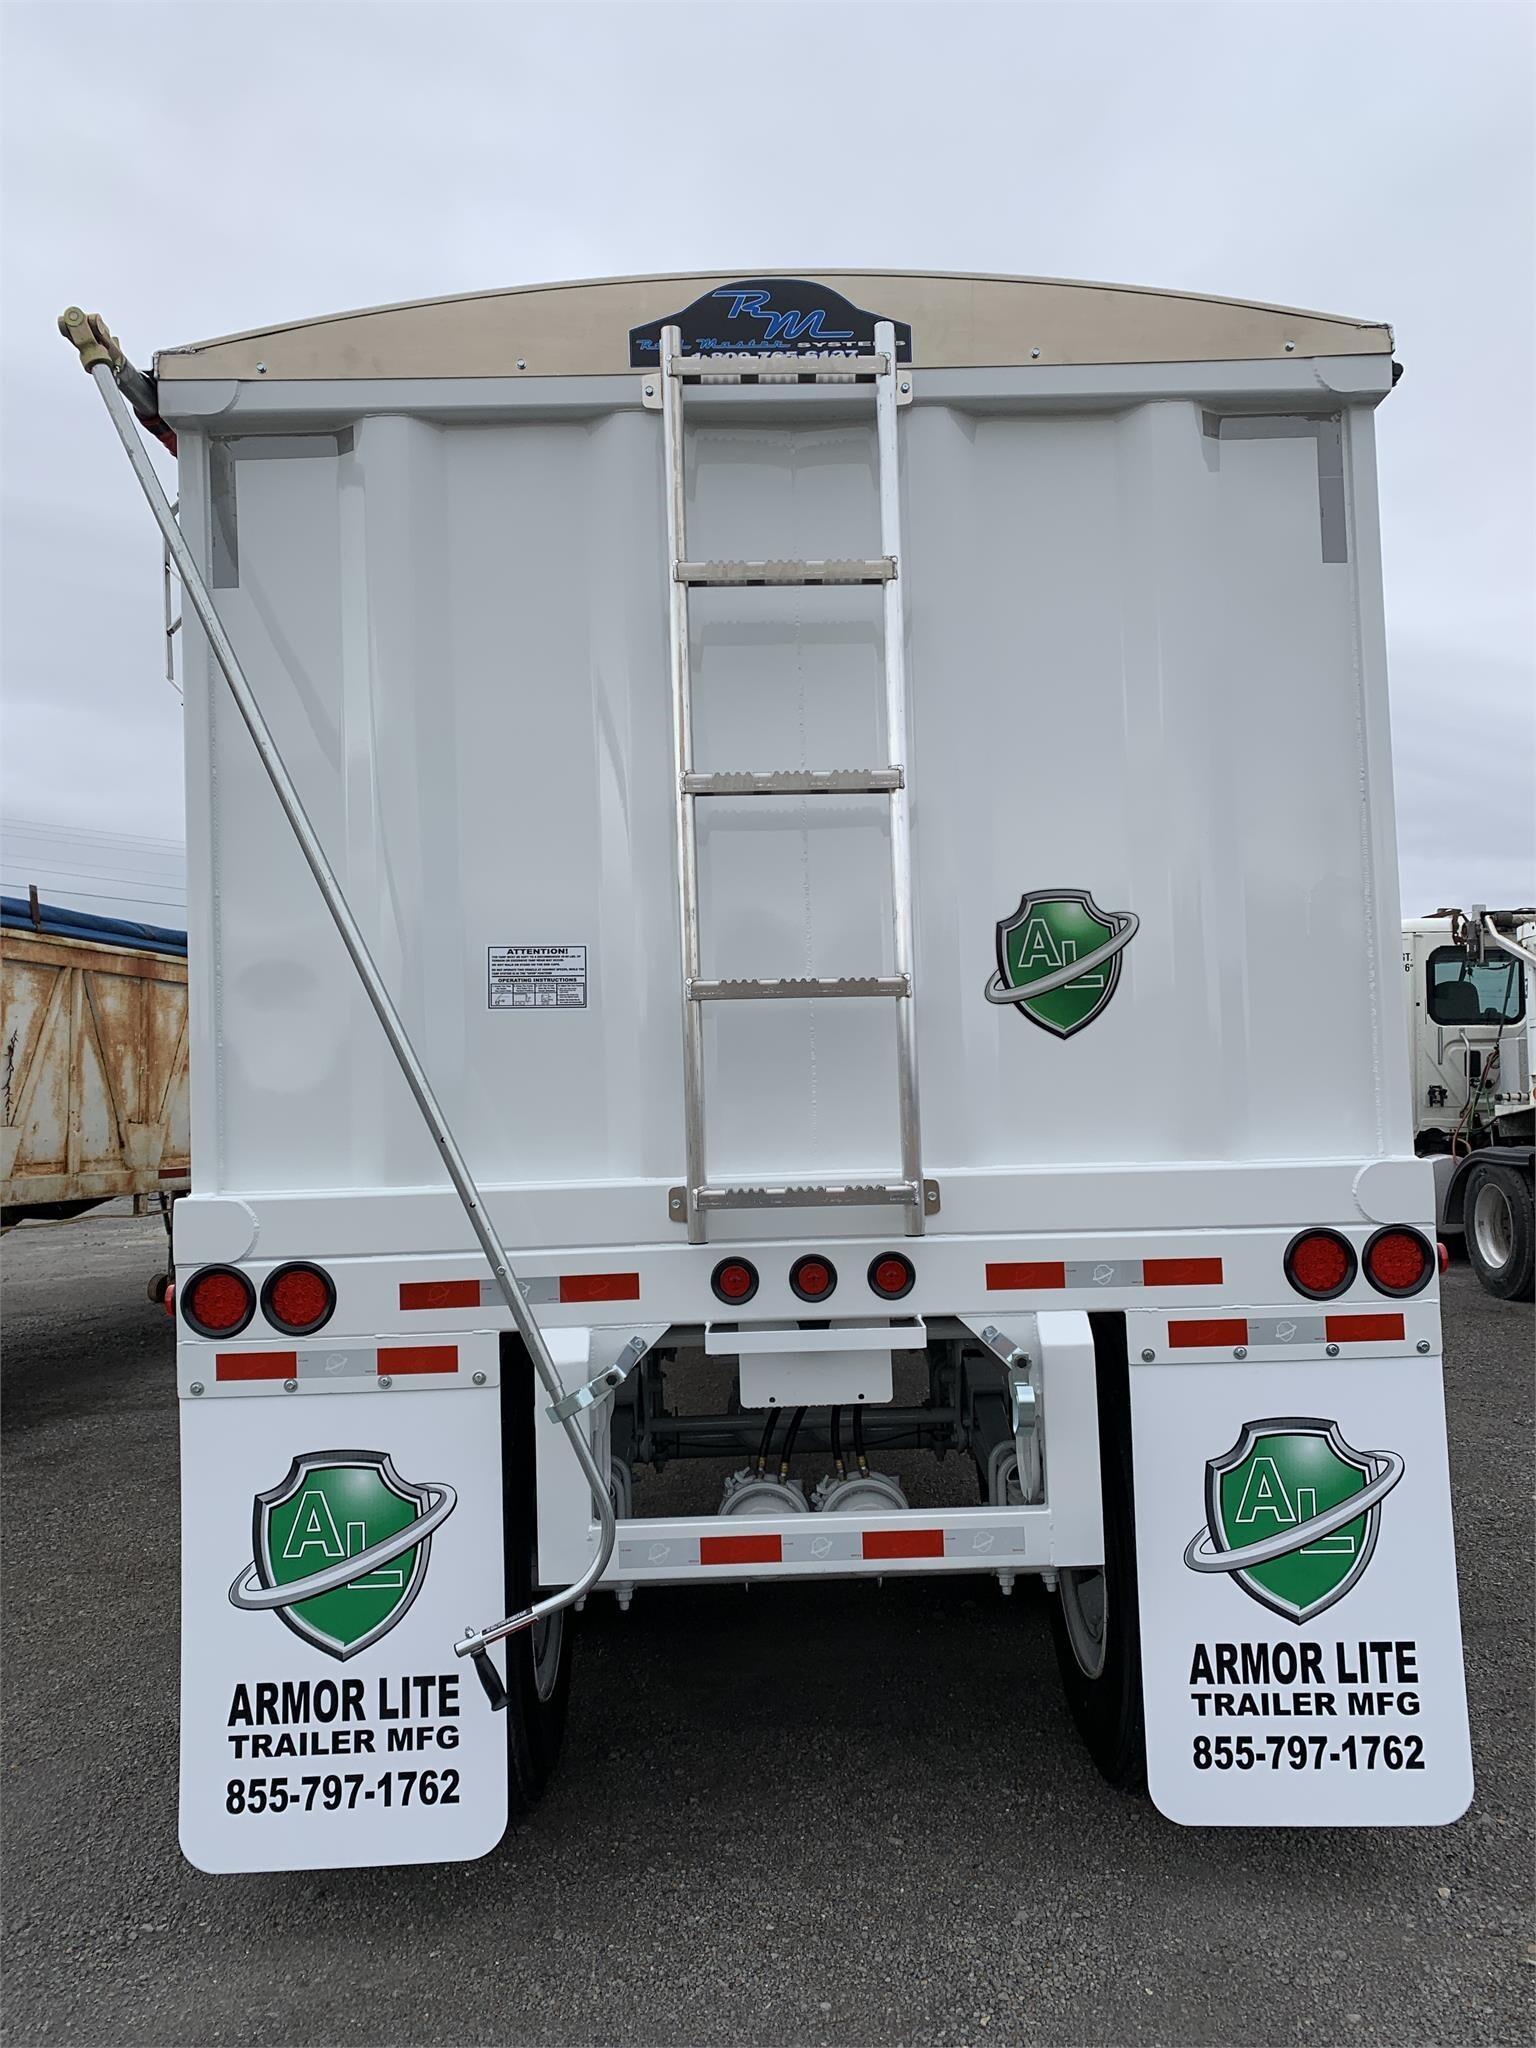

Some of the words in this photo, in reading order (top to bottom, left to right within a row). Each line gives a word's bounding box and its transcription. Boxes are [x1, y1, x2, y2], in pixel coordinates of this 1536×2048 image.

[712, 289, 854, 340] RM
[695, 338, 791, 350] Master
[797, 340, 906, 348] SYSTES
[1189, 1641, 1326, 1685] ARMOR
[1336, 1641, 1419, 1684] LITE
[227, 1679, 366, 1727] ARMOR
[379, 1674, 460, 1720] LITE
[1191, 1692, 1337, 1716] TRAILER
[1348, 1691, 1420, 1716] MFG
[228, 1729, 376, 1759] TRAILER
[387, 1725, 460, 1752] MFG
[1192, 1735, 1426, 1770] 855-797-1762
[225, 1768, 460, 1815] 855-797-1762
